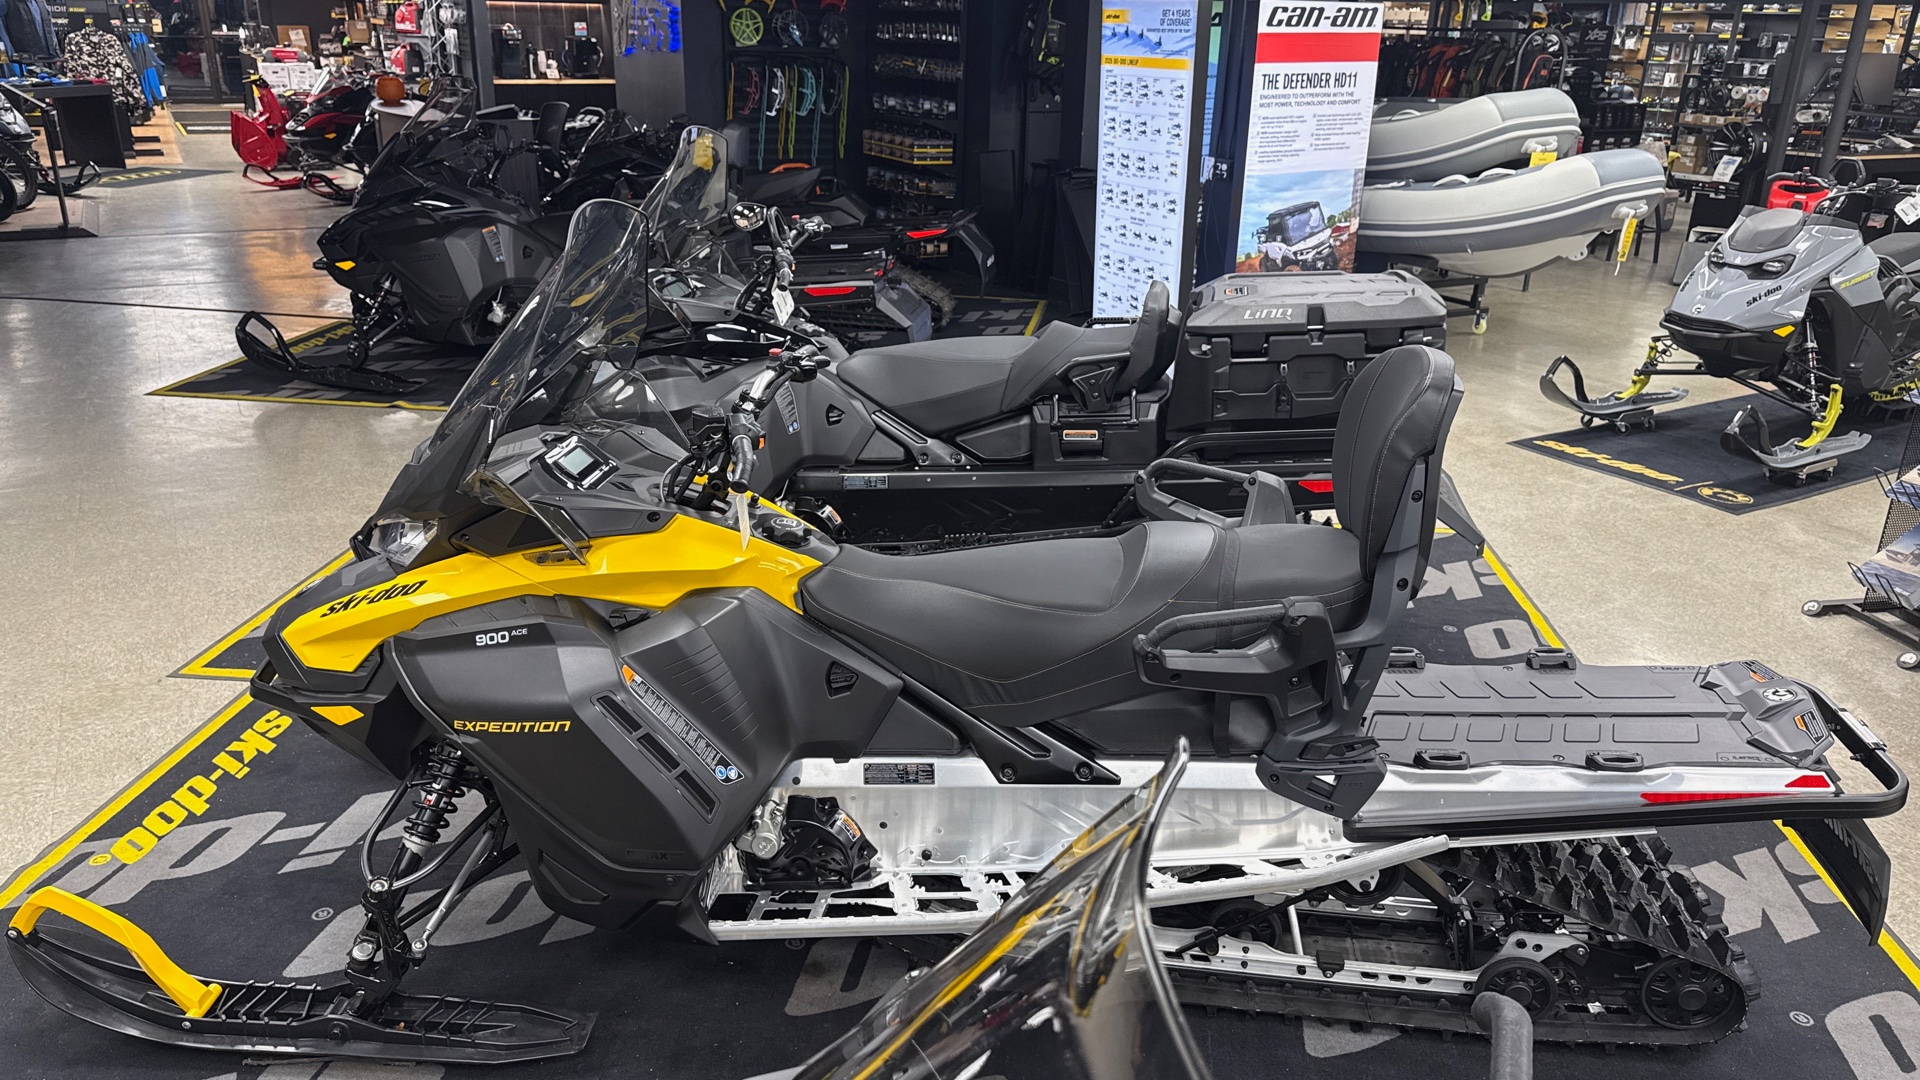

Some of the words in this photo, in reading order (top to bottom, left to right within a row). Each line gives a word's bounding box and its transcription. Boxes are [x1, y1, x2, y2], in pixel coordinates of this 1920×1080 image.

[1160, 18, 1166, 26] OF
[1162, 10, 1170, 18] GET
[1266, 6, 1379, 28] can-am
[1262, 74, 1280, 90] THE
[1283, 73, 1332, 90] DEFENDER
[1334, 72, 1358, 88] HD11
[1273, 101, 1293, 109] POWER,
[1839, 269, 1876, 290] SUMMIT
[1745, 284, 1782, 307] ski-doo
[319, 579, 428, 618] ski-doo
[475, 631, 510, 646] 900
[511, 628, 528, 636] ACE
[453, 719, 571, 733] EXPEDITION
[110, 709, 293, 865] ski-doo
